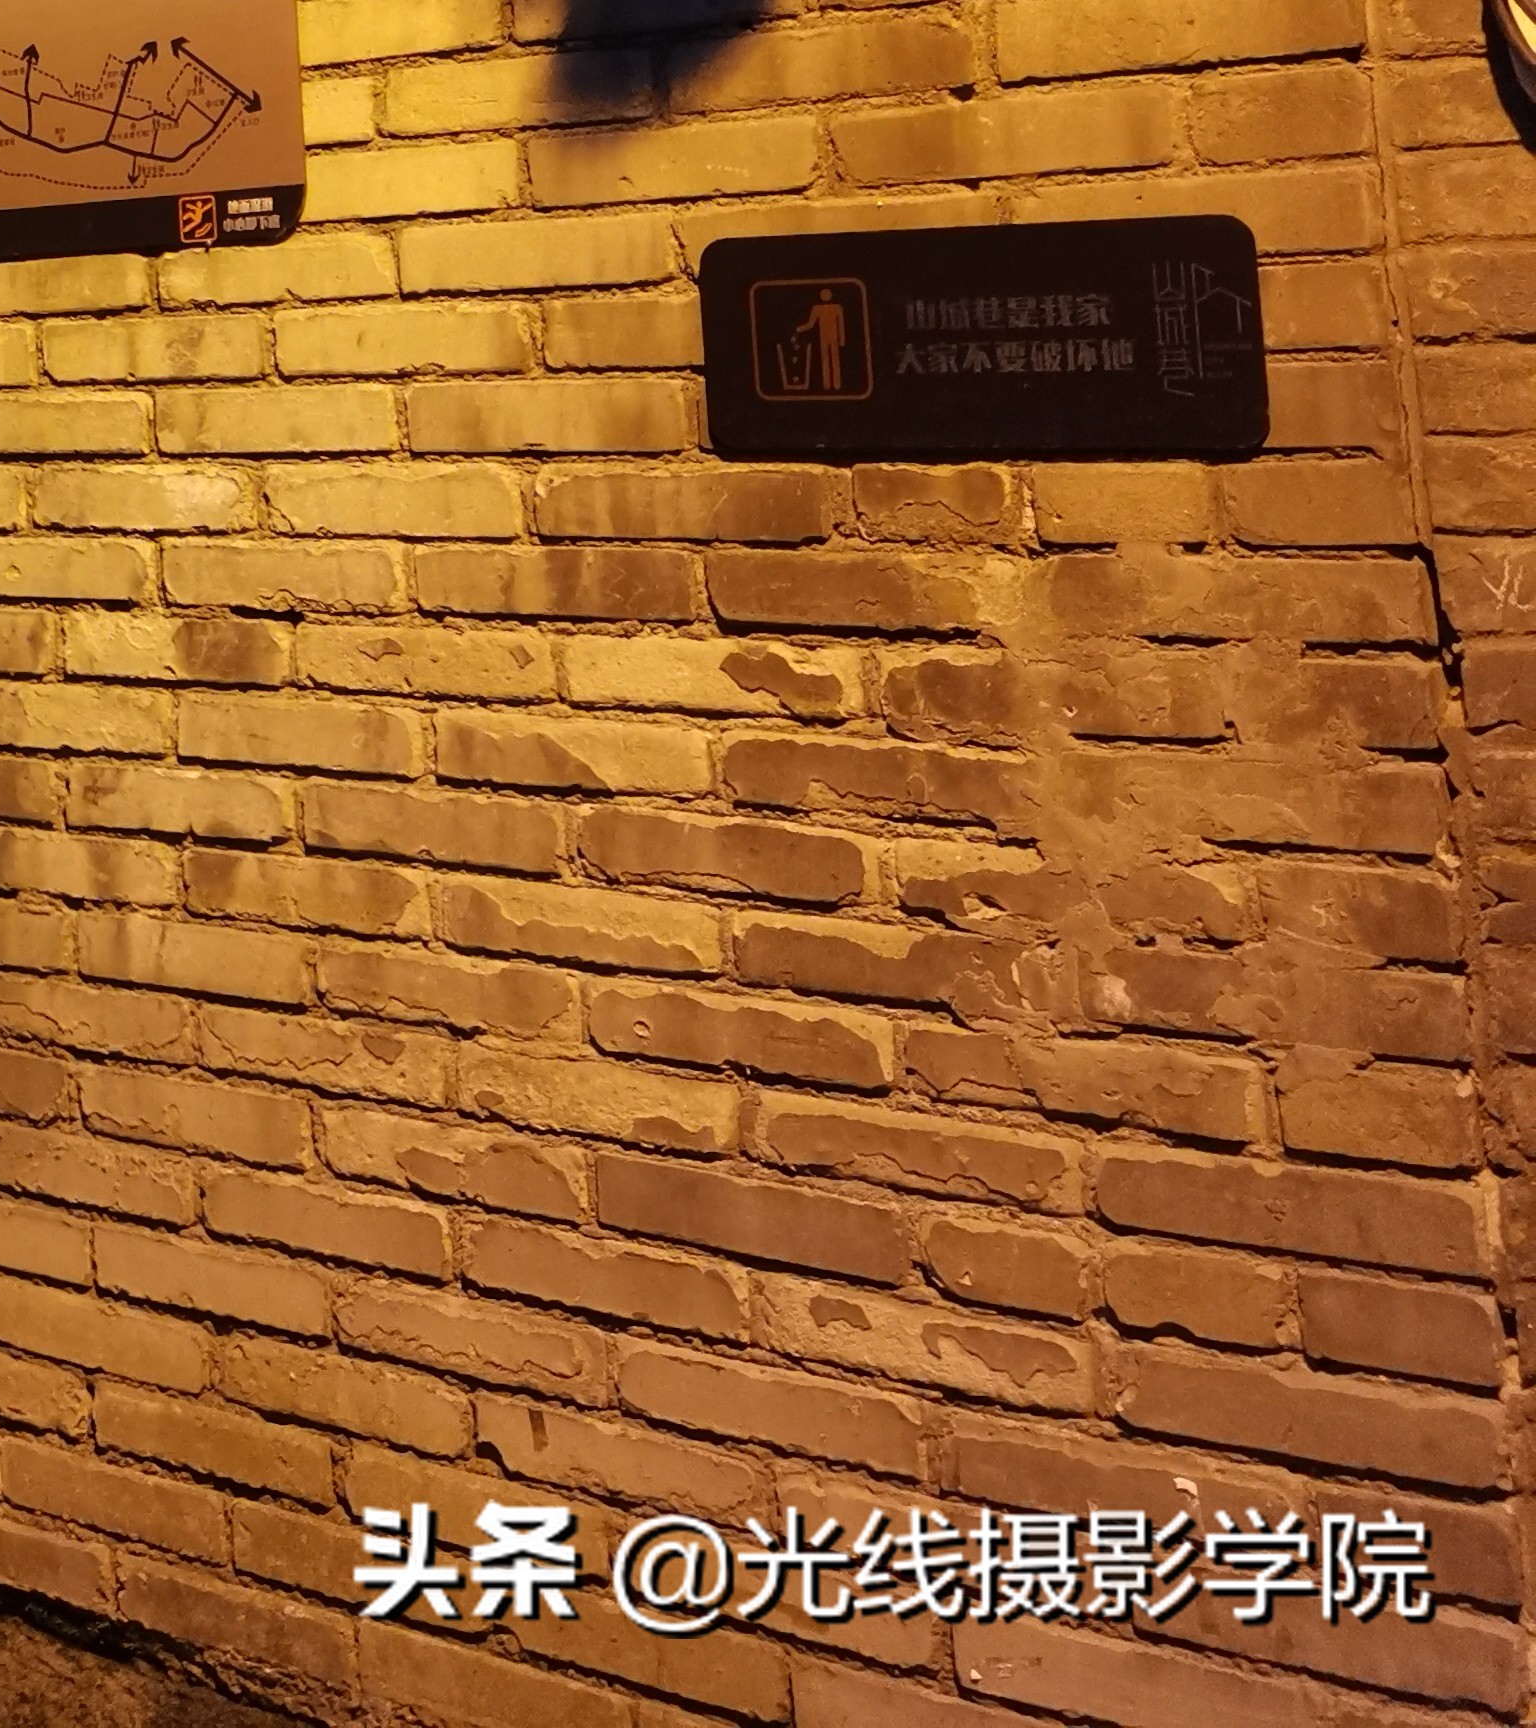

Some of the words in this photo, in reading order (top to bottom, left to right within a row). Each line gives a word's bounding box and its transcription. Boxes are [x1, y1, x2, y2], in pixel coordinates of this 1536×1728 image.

[905, 293, 1111, 330] 山城巷是我家
